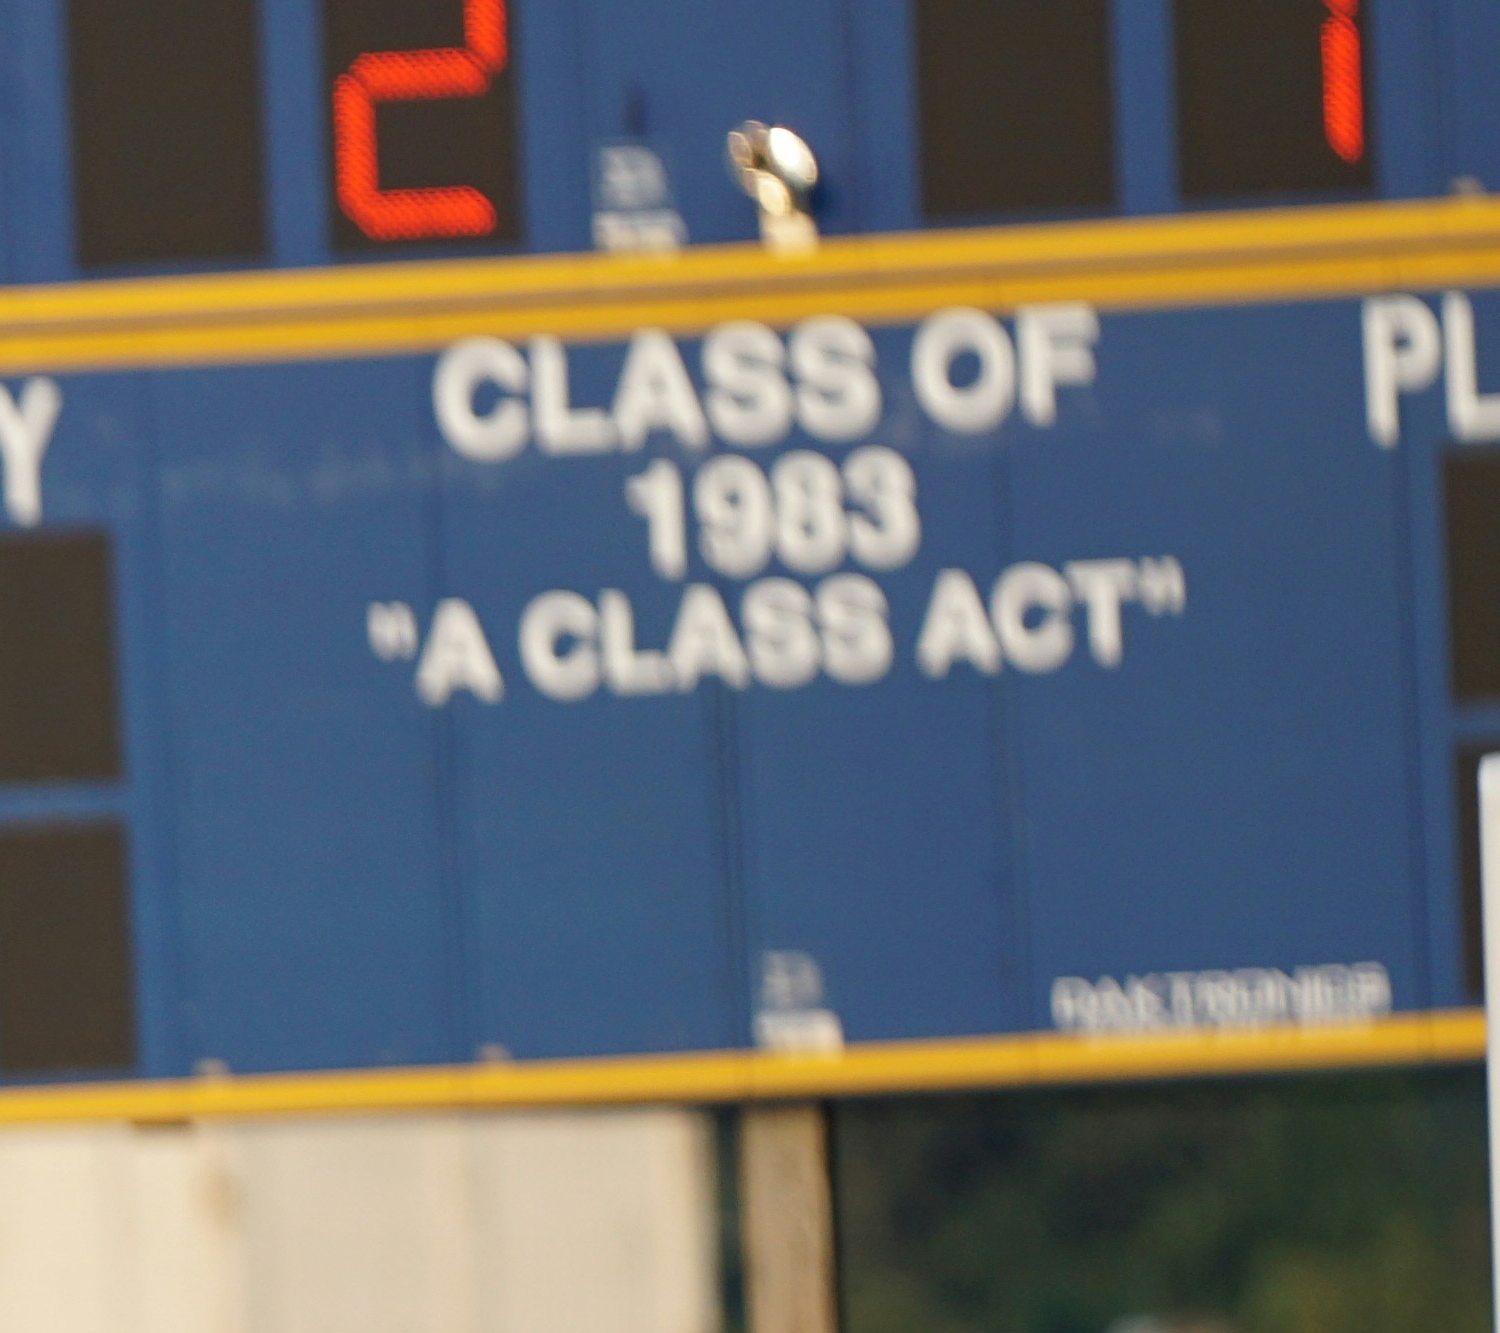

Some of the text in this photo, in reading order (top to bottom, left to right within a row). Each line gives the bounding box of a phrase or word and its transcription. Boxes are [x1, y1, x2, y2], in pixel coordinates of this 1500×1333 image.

[332, 0, 508, 240] 2
[431, 303, 1101, 463] CLASS OF
[1360, 289, 1500, 446] PL
[625, 446, 922, 579] 1983
[366, 557, 1188, 706] "A CLASS ACT"
